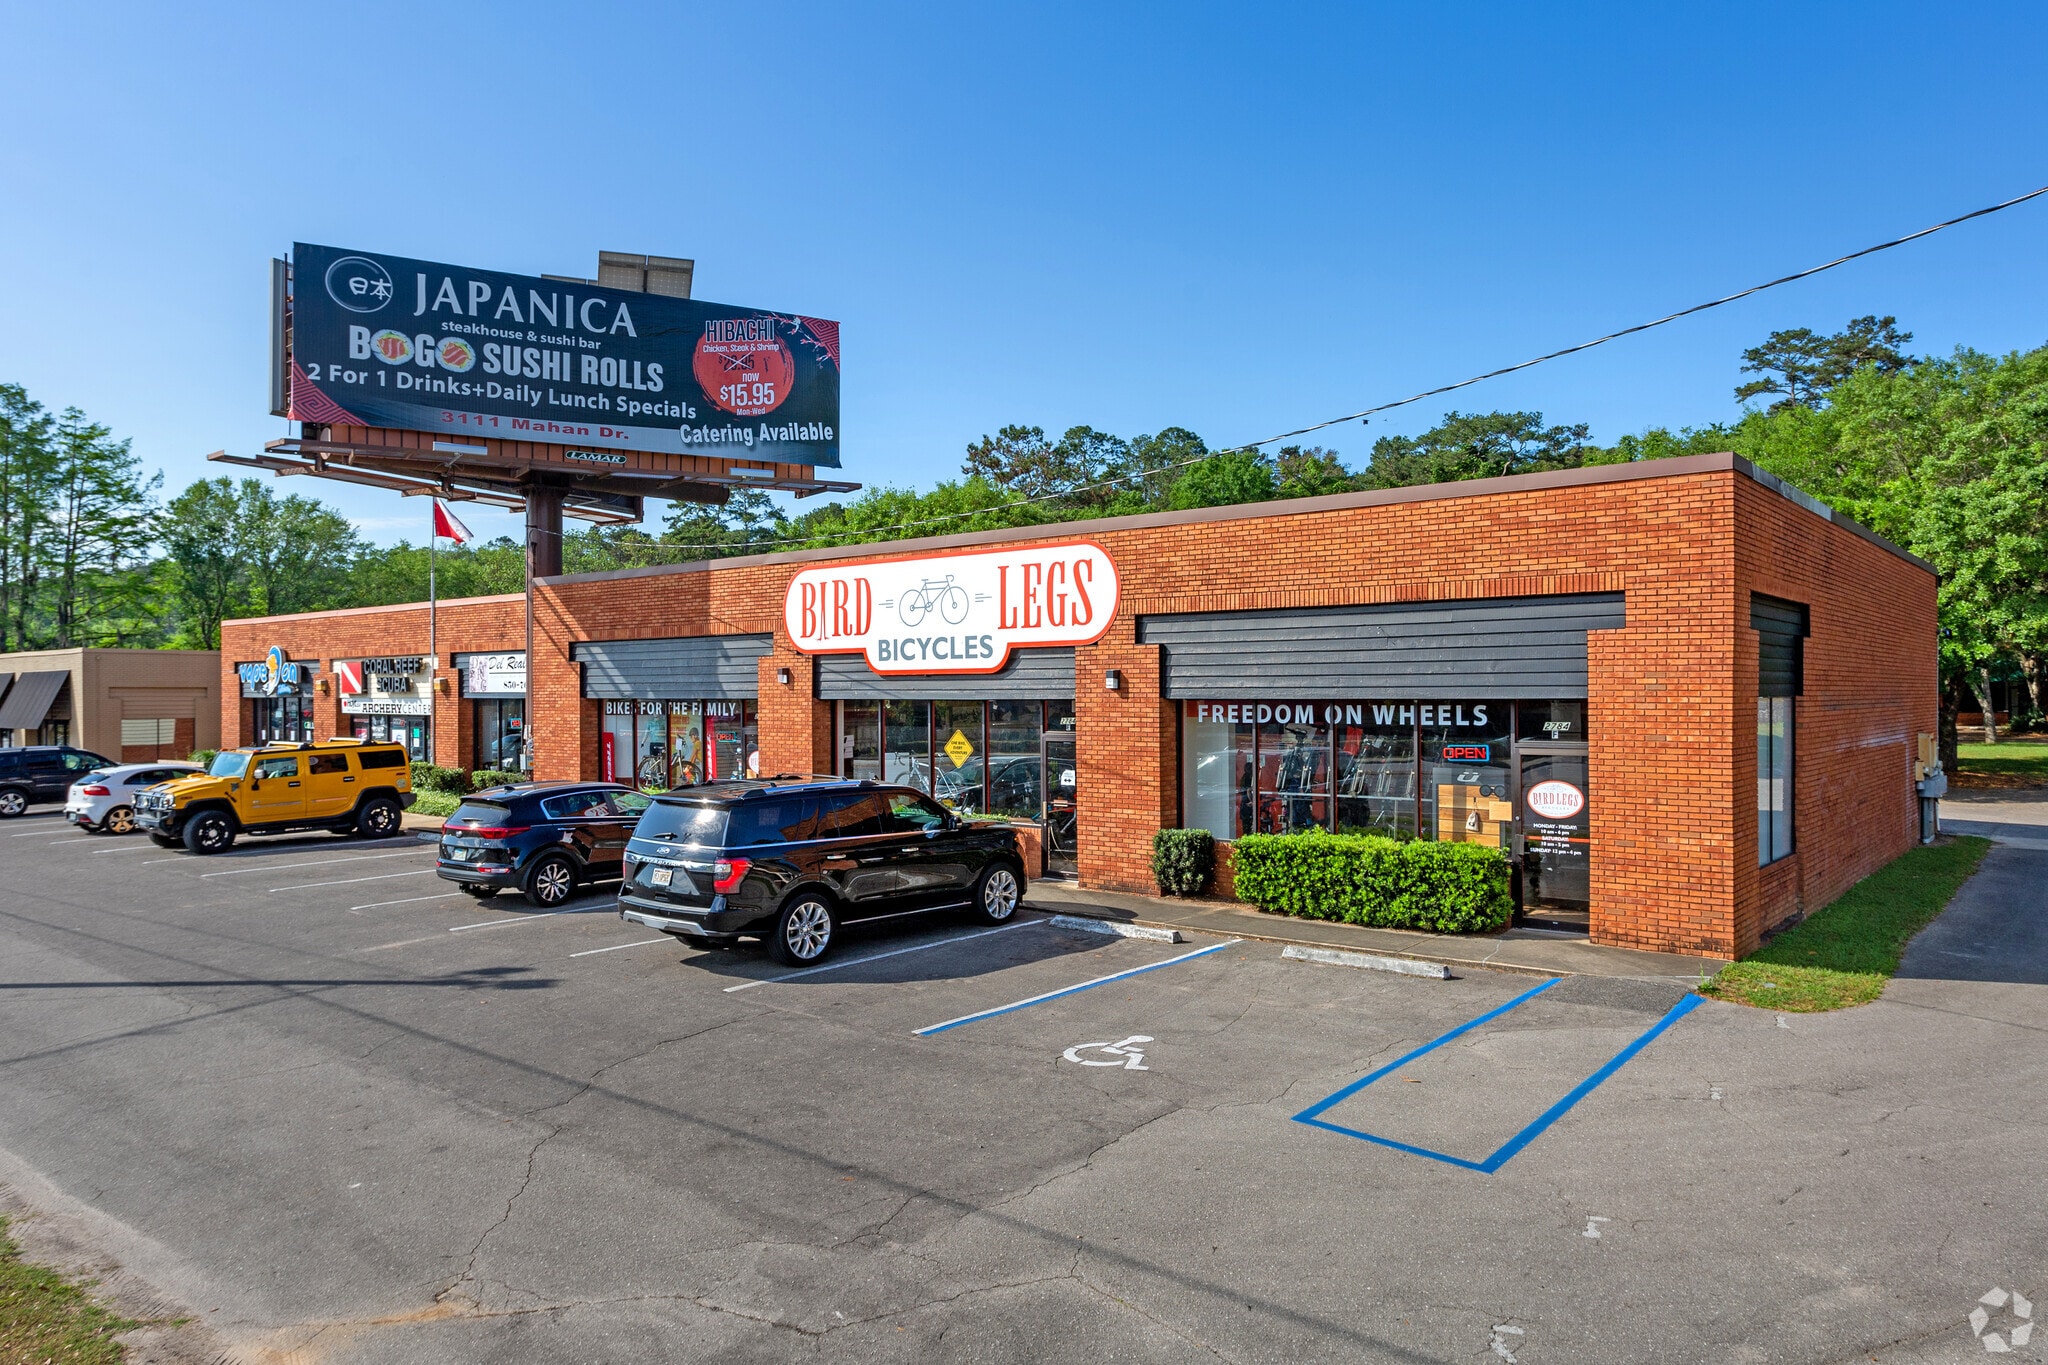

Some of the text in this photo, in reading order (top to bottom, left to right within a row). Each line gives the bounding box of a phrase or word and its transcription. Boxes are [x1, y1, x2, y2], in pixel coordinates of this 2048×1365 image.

[349, 276, 391, 300] 日本
[413, 272, 637, 337] JAPANICA
[441, 321, 602, 349] steakhouse & sushi bar
[705, 319, 775, 343] HIBACHI
[349, 324, 664, 392] BOGO SUSHI ROLLS
[702, 343, 780, 354] Chicken, Steak & Shrimp
[742, 373, 760, 382] now
[307, 362, 697, 420] 2 For 1 Drinks+Daily Lunch Specials
[720, 382, 775, 407] $15.95
[736, 407, 766, 416] Mon-Wed
[441, 411, 630, 440] 3111 Mahan Dr.
[680, 422, 834, 447] Catering Available
[570, 452, 621, 463] LAMAR
[800, 558, 1093, 641] BIRD LEGS
[878, 634, 993, 662] BICYCLES
[364, 658, 420, 675] CORAL REEF
[377, 677, 407, 692] SCUBA
[362, 703, 402, 714] ARCHERY
[640, 702, 662, 715] FOR
[1197, 704, 1488, 726] FREEDOM ON WHEELS
[1544, 722, 1570, 730] 2784
[1443, 747, 1486, 760] OPEN
[1556, 793, 1579, 807] LEGS
